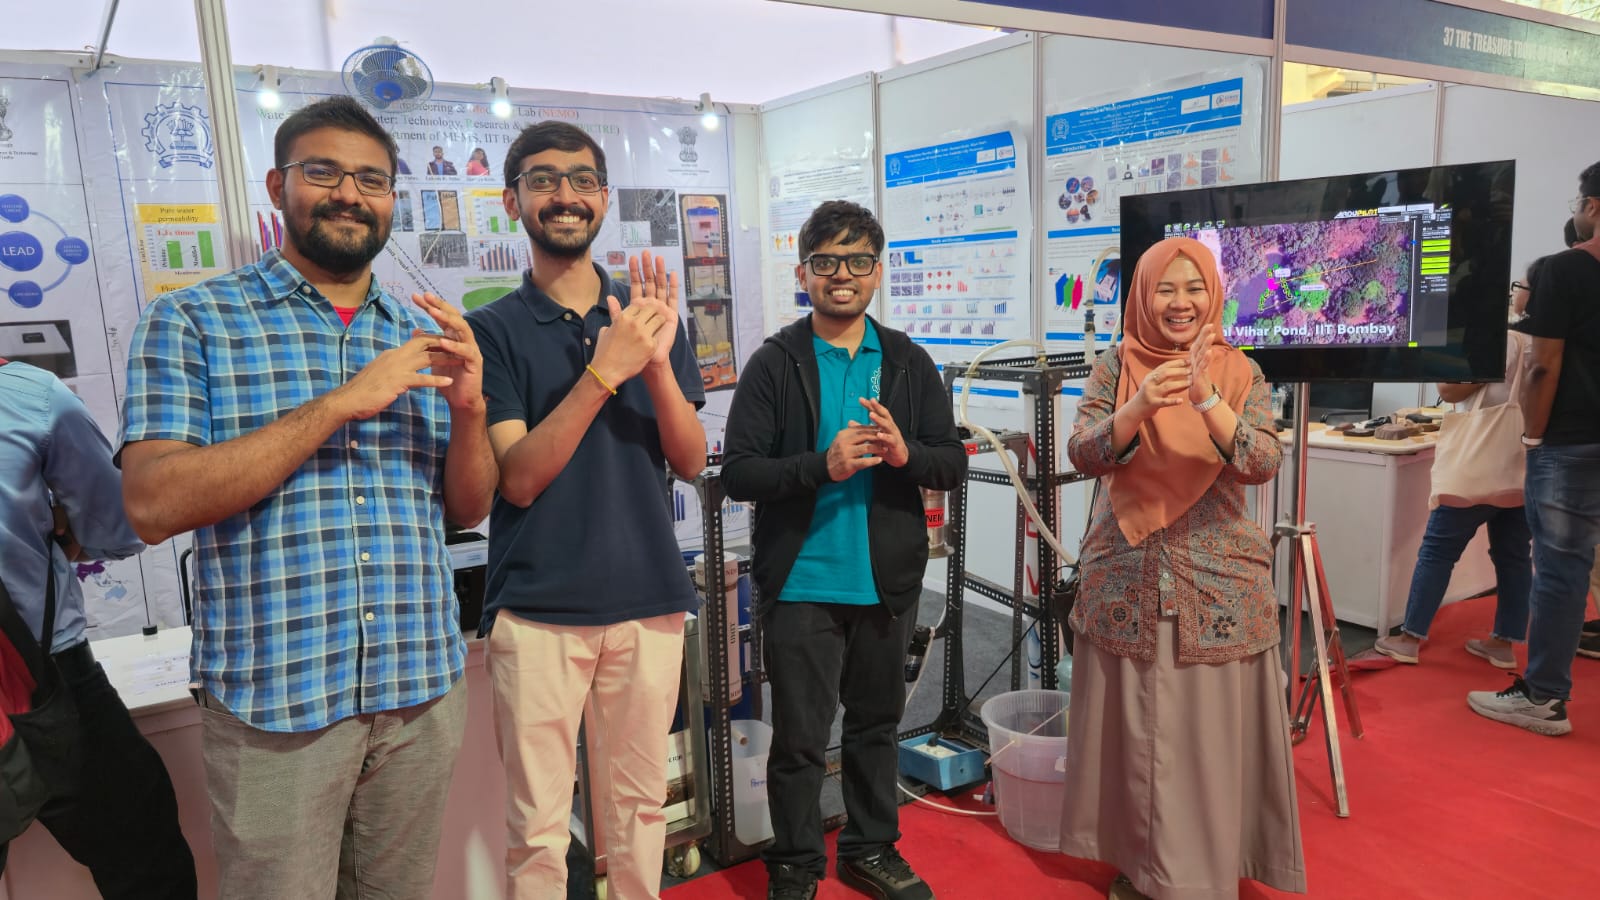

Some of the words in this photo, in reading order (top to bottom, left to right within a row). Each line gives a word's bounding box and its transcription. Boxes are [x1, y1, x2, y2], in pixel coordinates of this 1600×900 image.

[1443, 26, 1454, 47] 37
[1456, 29, 1471, 50] THE
[1472, 32, 1512, 57] TREASURE
[256, 108, 286, 120] Wate
[403, 115, 462, 130] Technology,
[466, 117, 510, 130] Research
[518, 107, 536, 117] Lab
[538, 108, 579, 119] (NEMO)
[430, 132, 440, 141] of
[484, 133, 501, 143] IIT
[2, 246, 36, 256] LEAD
[1235, 325, 1269, 337] Vihar
[1273, 324, 1311, 337] Pond,
[1315, 324, 1333, 335] IIT
[1337, 323, 1396, 340] Bombay
